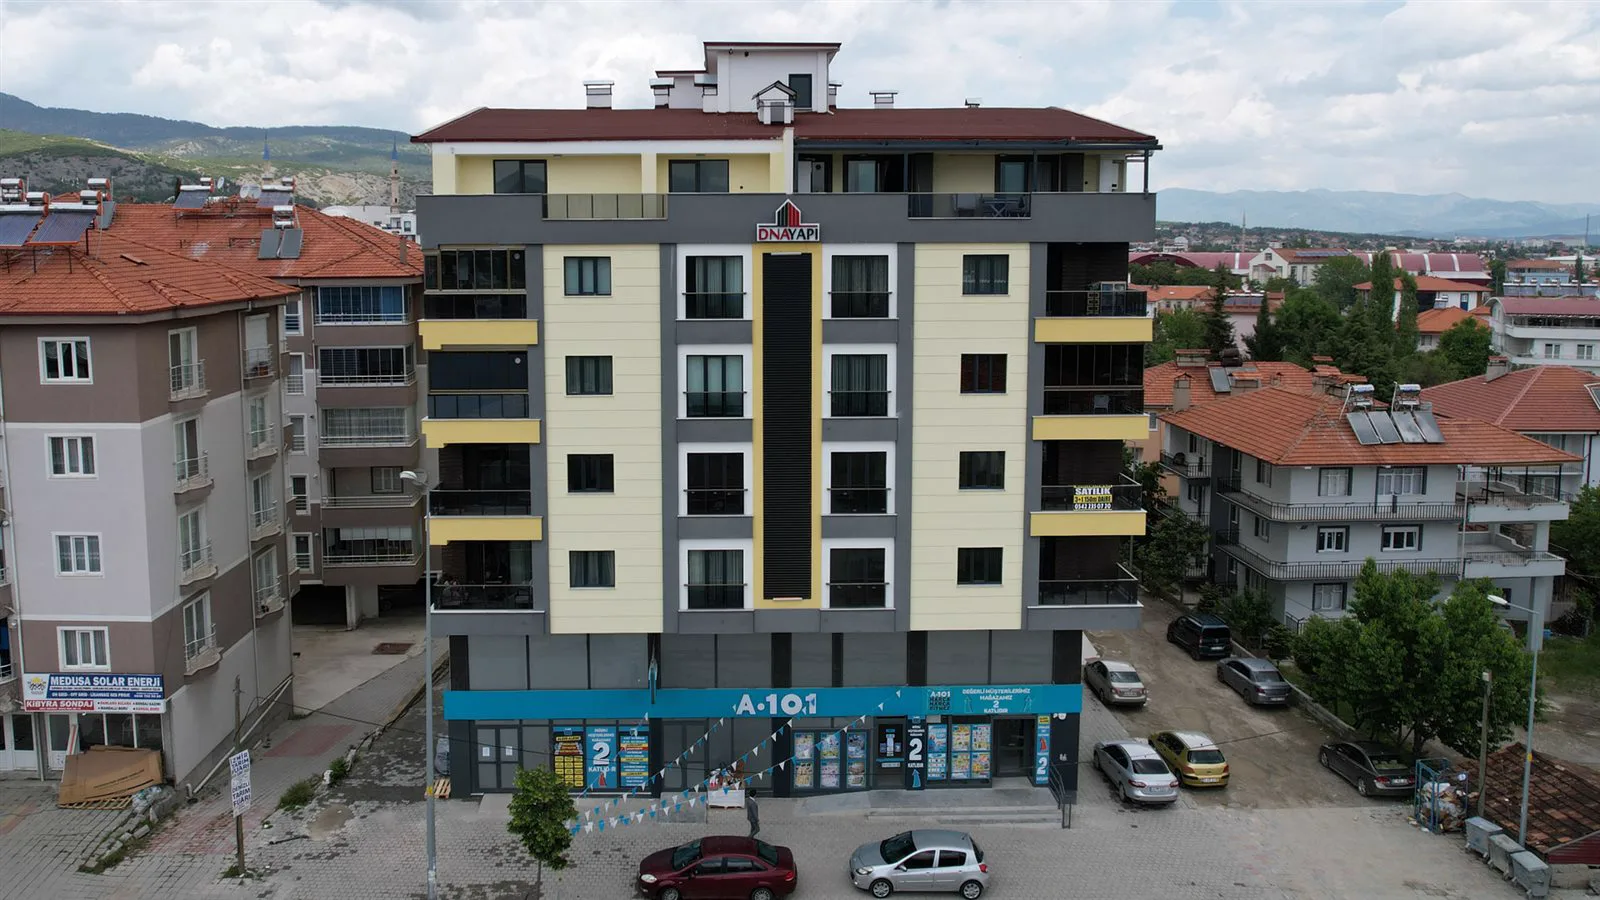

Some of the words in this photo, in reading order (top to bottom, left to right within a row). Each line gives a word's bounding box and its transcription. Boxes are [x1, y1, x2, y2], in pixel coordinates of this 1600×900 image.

[1075, 487, 1111, 495] SATILIK
[51, 676, 91, 686] MEDUSA
[93, 677, 125, 686] SOLAR
[60, 700, 93, 708] SONDAJ
[993, 700, 1000, 708] 2
[592, 742, 610, 766] 2
[909, 738, 923, 760] 2
[1037, 757, 1048, 774] 2
